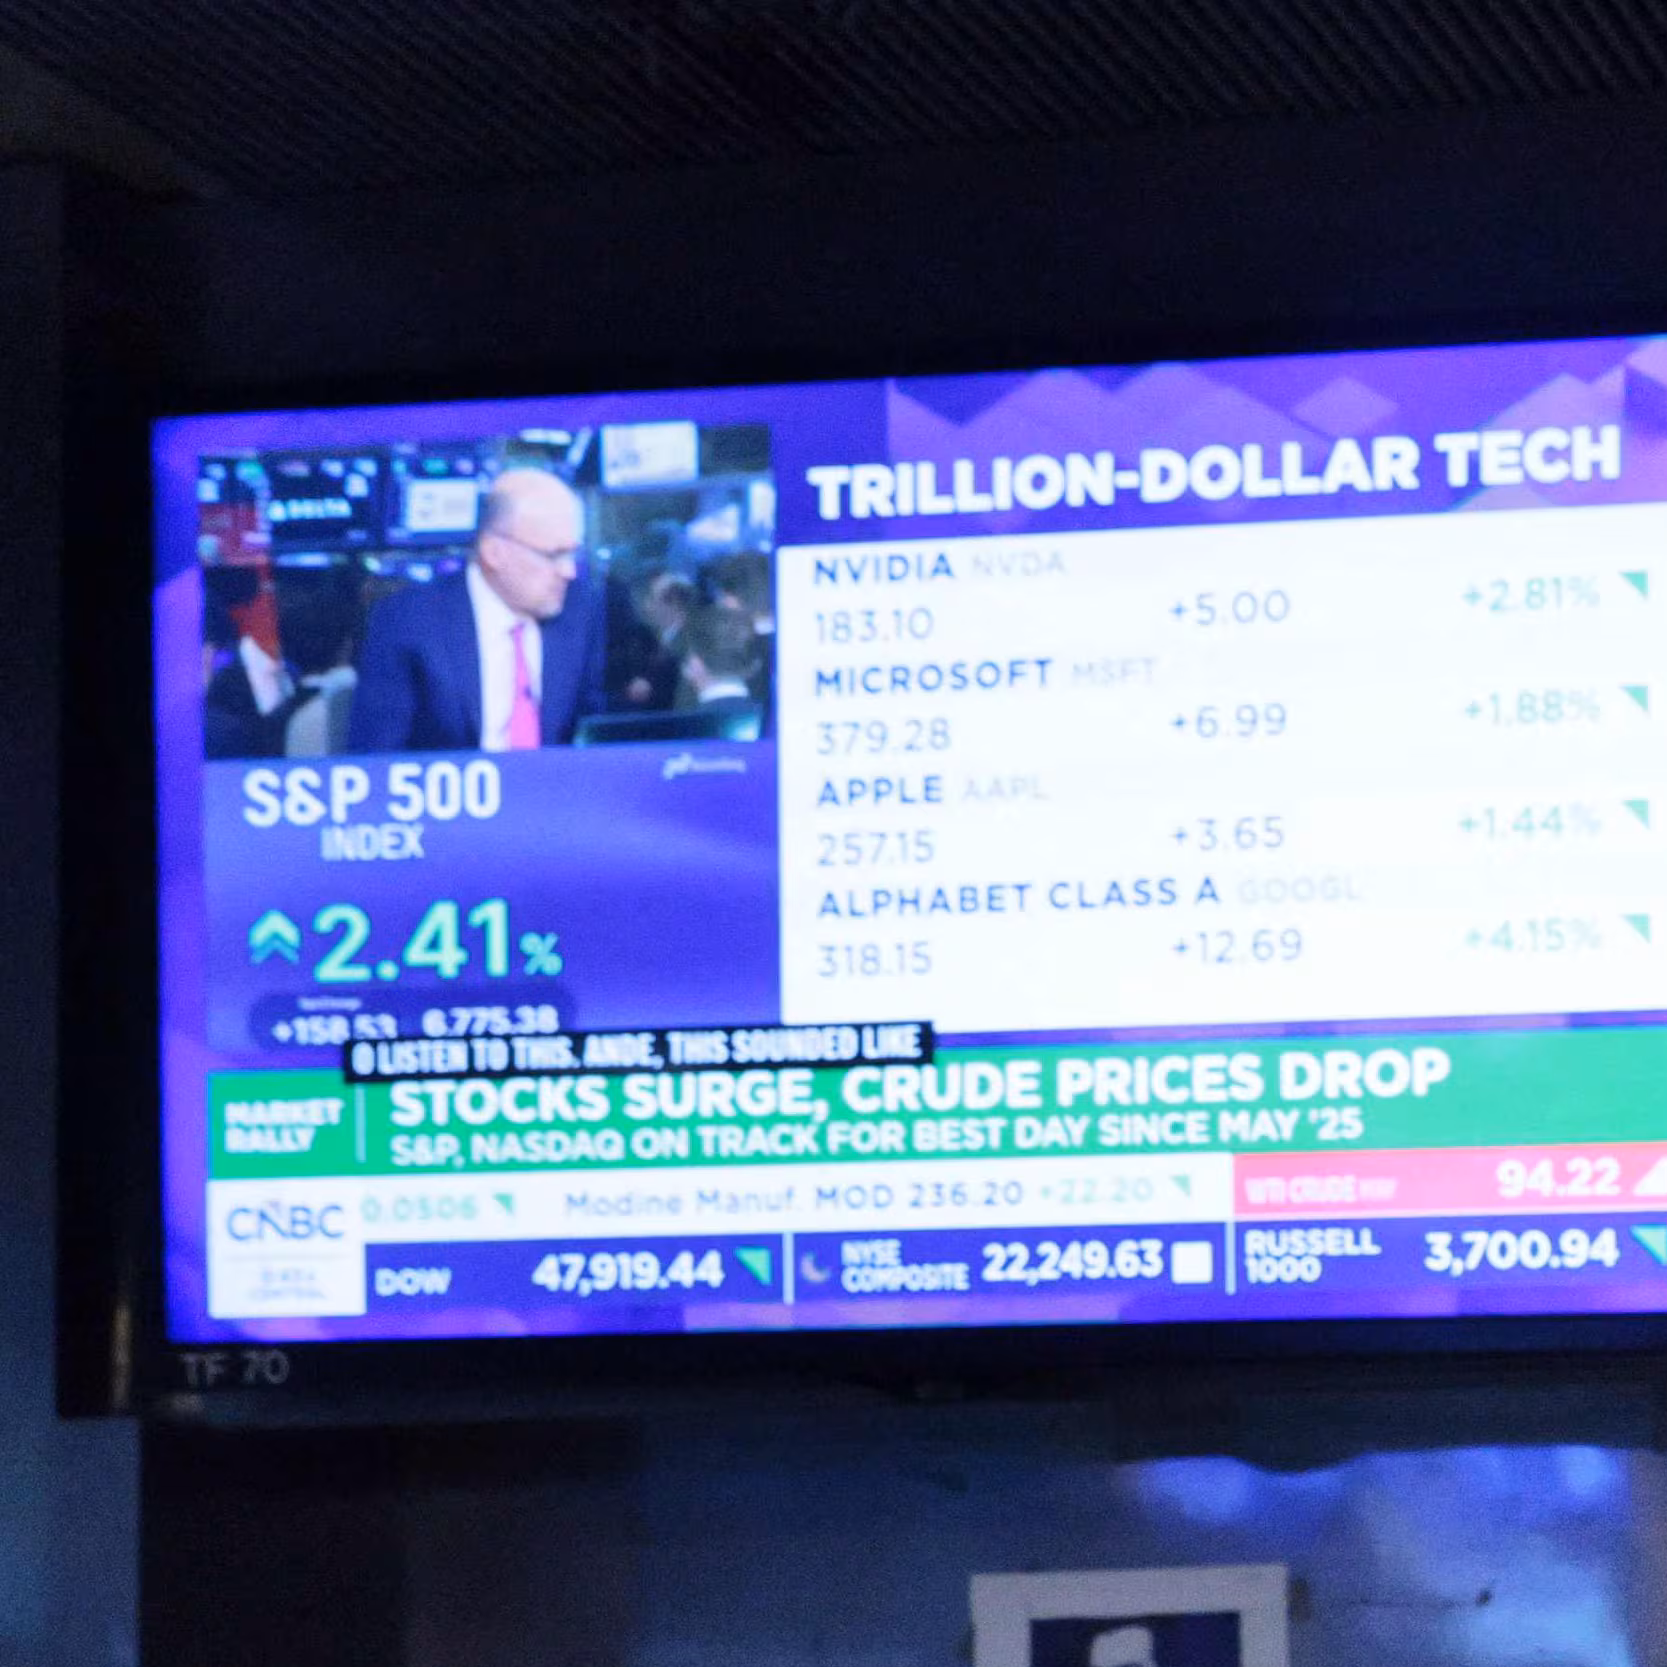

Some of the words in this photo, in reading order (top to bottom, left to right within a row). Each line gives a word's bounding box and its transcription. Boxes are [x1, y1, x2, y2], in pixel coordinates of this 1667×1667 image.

[807, 437, 1420, 522] TRILLION-DOLLAR
[1435, 424, 1622, 489] TECH
[812, 553, 955, 587] NVIDIA
[971, 549, 1065, 579] NVDA
[814, 606, 935, 646] 183.10
[1170, 589, 1291, 627] +5.00
[1462, 573, 1602, 614] +2.81%
[814, 657, 1054, 698] MICROSOFT
[1072, 655, 1159, 689] MSFT
[815, 717, 952, 757] 379.28
[1170, 702, 1288, 741] +6.99
[1464, 687, 1602, 727] +1.88%
[243, 768, 370, 829] S&P
[386, 759, 502, 821] 500
[816, 773, 944, 809] APPLE
[962, 770, 1051, 803] AAPL
[320, 823, 425, 862] INDEX
[815, 829, 935, 869] 257.15
[1170, 816, 1286, 854] +3.65
[1457, 803, 1602, 840] +1.44%
[817, 882, 1033, 921] ALPHABET
[1048, 877, 1180, 913] CLASS
[1195, 875, 1222, 906] A
[816, 941, 933, 980] 318.15
[1172, 926, 1304, 966] +12.69
[1464, 917, 1602, 956] +4.15%
[378, 1038, 469, 1074] LISTEN
[473, 1037, 508, 1071] TO
[667, 1030, 729, 1065] THIS
[731, 1026, 857, 1062] SOUNDED
[862, 1023, 922, 1058] LIKE
[390, 1072, 612, 1127] STOCKS
[623, 1068, 828, 1122] SURGE,
[839, 1058, 1041, 1115] CRUDE
[1056, 1053, 1265, 1106] PRICES
[1278, 1046, 1452, 1100] DROP
[224, 1096, 345, 1127] MARKET
[224, 1122, 319, 1153] RALLY
[472, 1124, 624, 1164] NASDAQ
[633, 1124, 691, 1159] ON
[697, 1120, 818, 1158] TRACK
[828, 1118, 905, 1154] FOR
[912, 1115, 1008, 1152] BEST
[1015, 1113, 1089, 1149] DAY
[1098, 1110, 1211, 1147] SINCE
[1218, 1107, 1299, 1144] MAY
[565, 1187, 685, 1218] Modine
[814, 1182, 895, 1210] MOD
[907, 1178, 1022, 1208] 236.20
[1496, 1157, 1620, 1200] 94.22
[227, 1200, 345, 1242] CNBC
[1245, 1226, 1381, 1259] RUSSELL
[841, 1239, 900, 1267] NYSE
[982, 1238, 1164, 1286] 22,249.63
[1245, 1256, 1322, 1285] 1000
[1423, 1226, 1620, 1274] 3,700.94
[375, 1266, 452, 1296] DOW
[531, 1250, 725, 1297] 47,919.44
[841, 1262, 971, 1294] COMPOSITE
[182, 1352, 230, 1388] TF
[238, 1349, 290, 1385] 70
